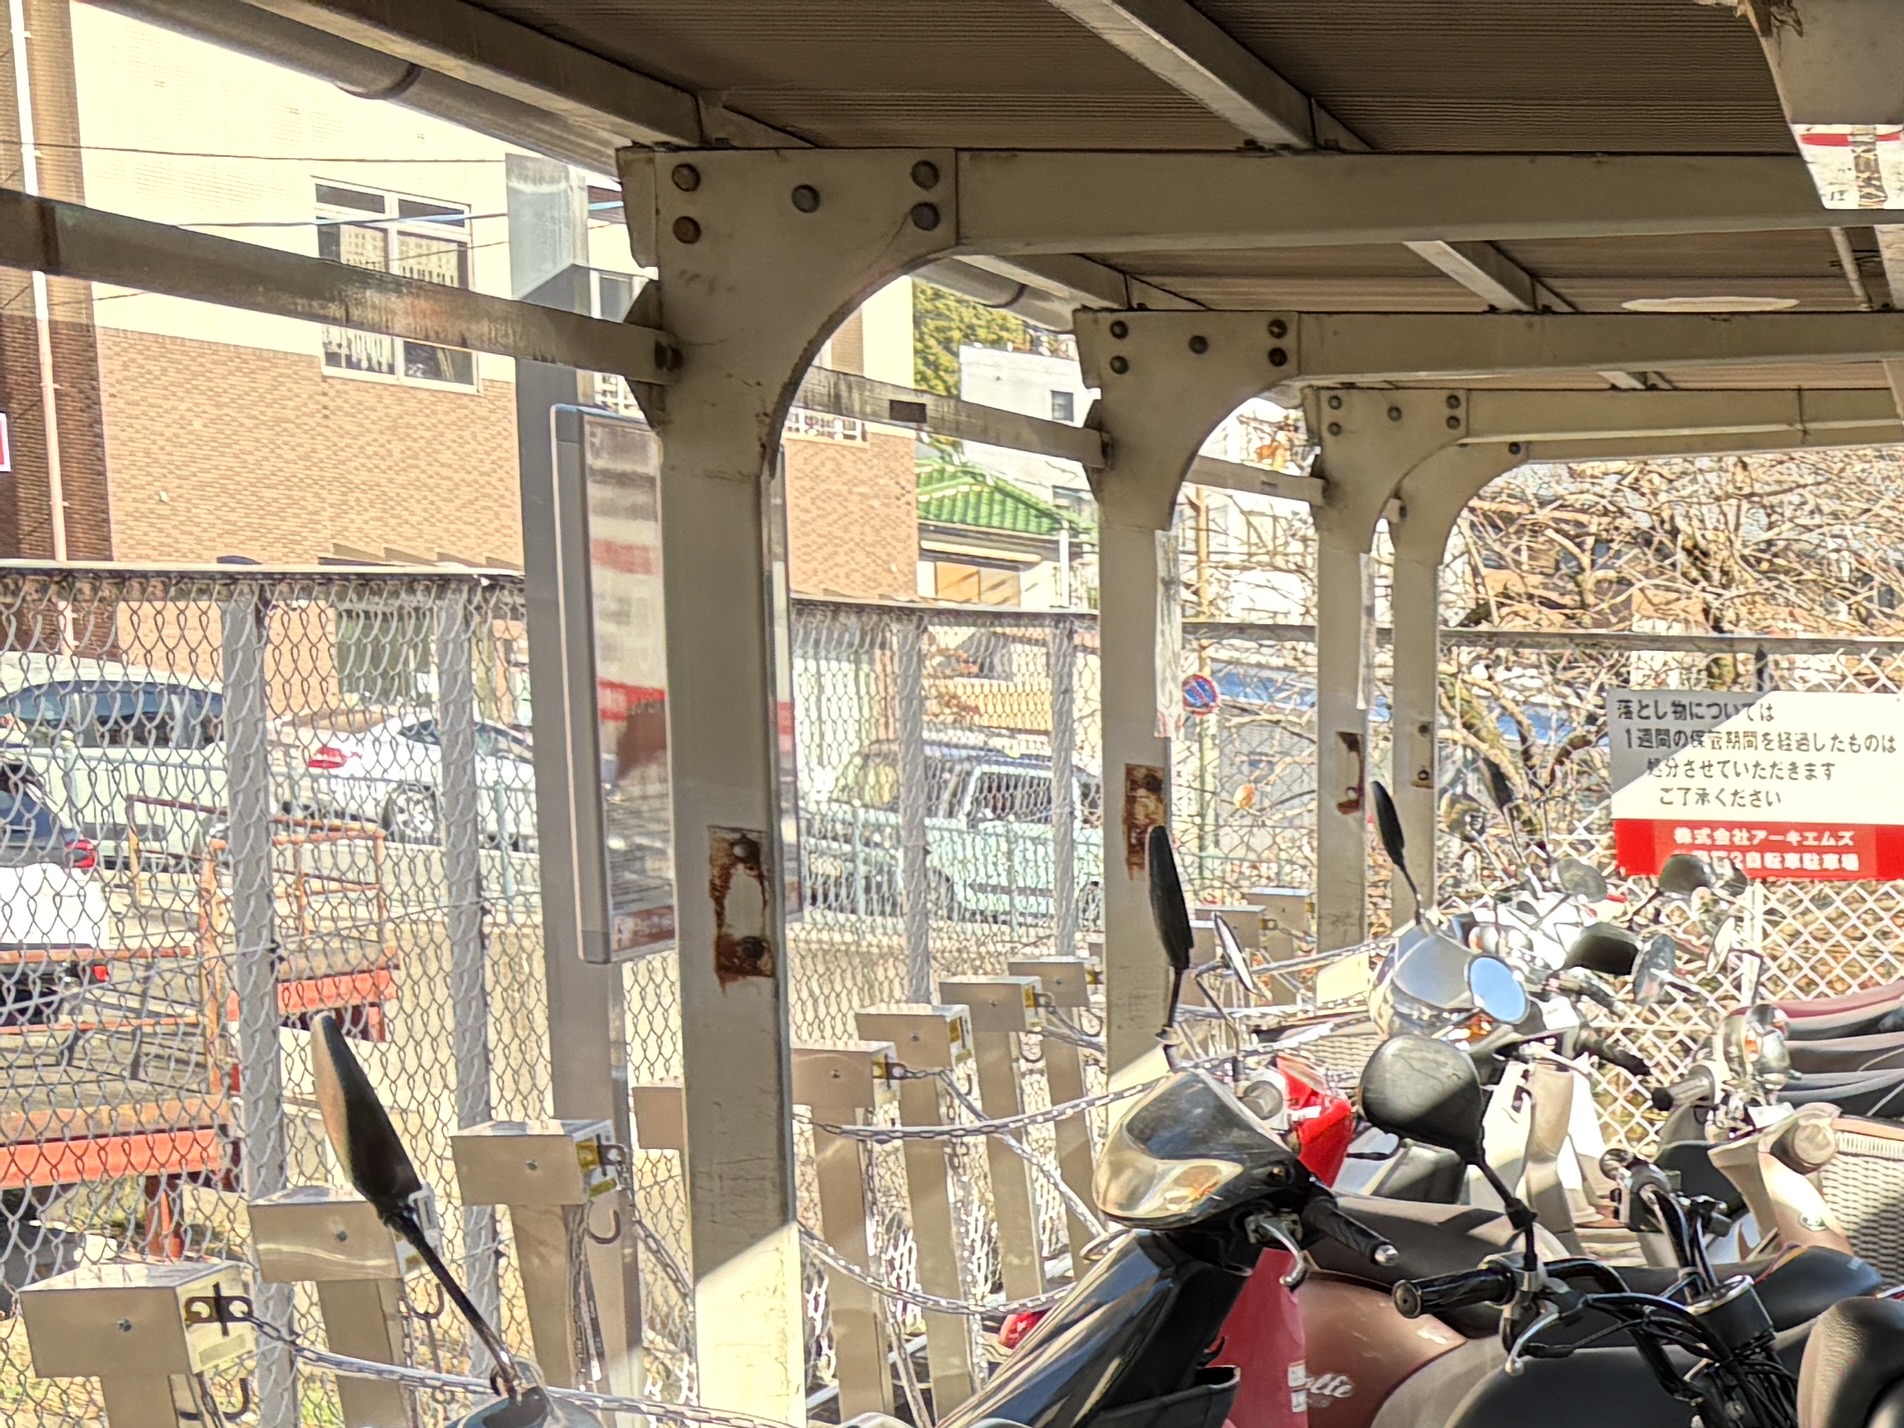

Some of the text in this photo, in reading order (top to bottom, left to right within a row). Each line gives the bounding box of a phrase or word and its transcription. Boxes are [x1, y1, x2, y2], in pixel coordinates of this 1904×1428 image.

[1616, 698, 1775, 723] 落とし物については
[1646, 756, 1837, 781] 処分させていただきます
[1659, 786, 1782, 808] ご了承ください
[1673, 826, 1855, 848] 株式会社アーキエムズ
